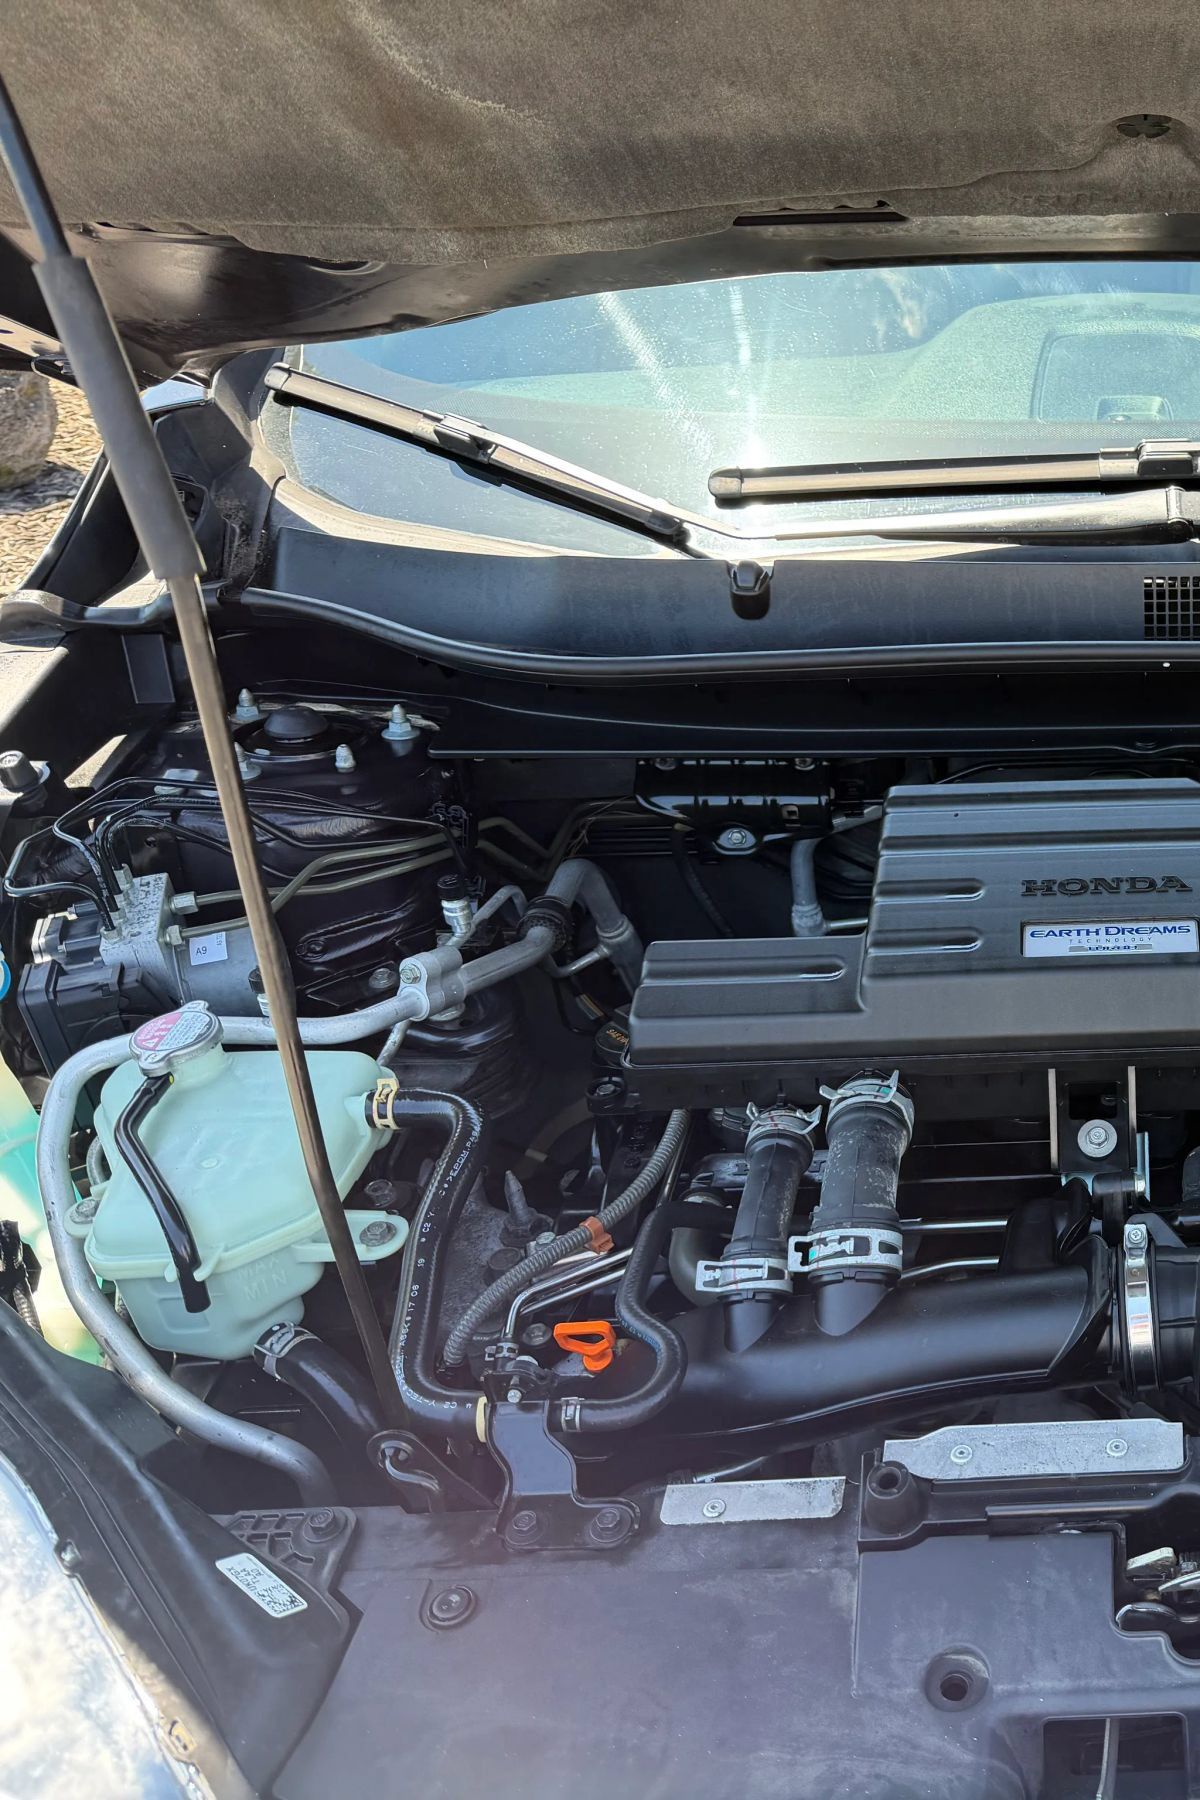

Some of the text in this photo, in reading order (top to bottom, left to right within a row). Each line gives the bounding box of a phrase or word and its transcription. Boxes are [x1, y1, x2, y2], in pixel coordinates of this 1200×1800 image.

[1021, 875, 1193, 897] HONDA
[1029, 924, 1191, 938] EARTH DREAMS
[1068, 936, 1153, 944] TECHNOLOGY
[195, 945, 207, 956] A9
[243, 1269, 288, 1302] MIN
